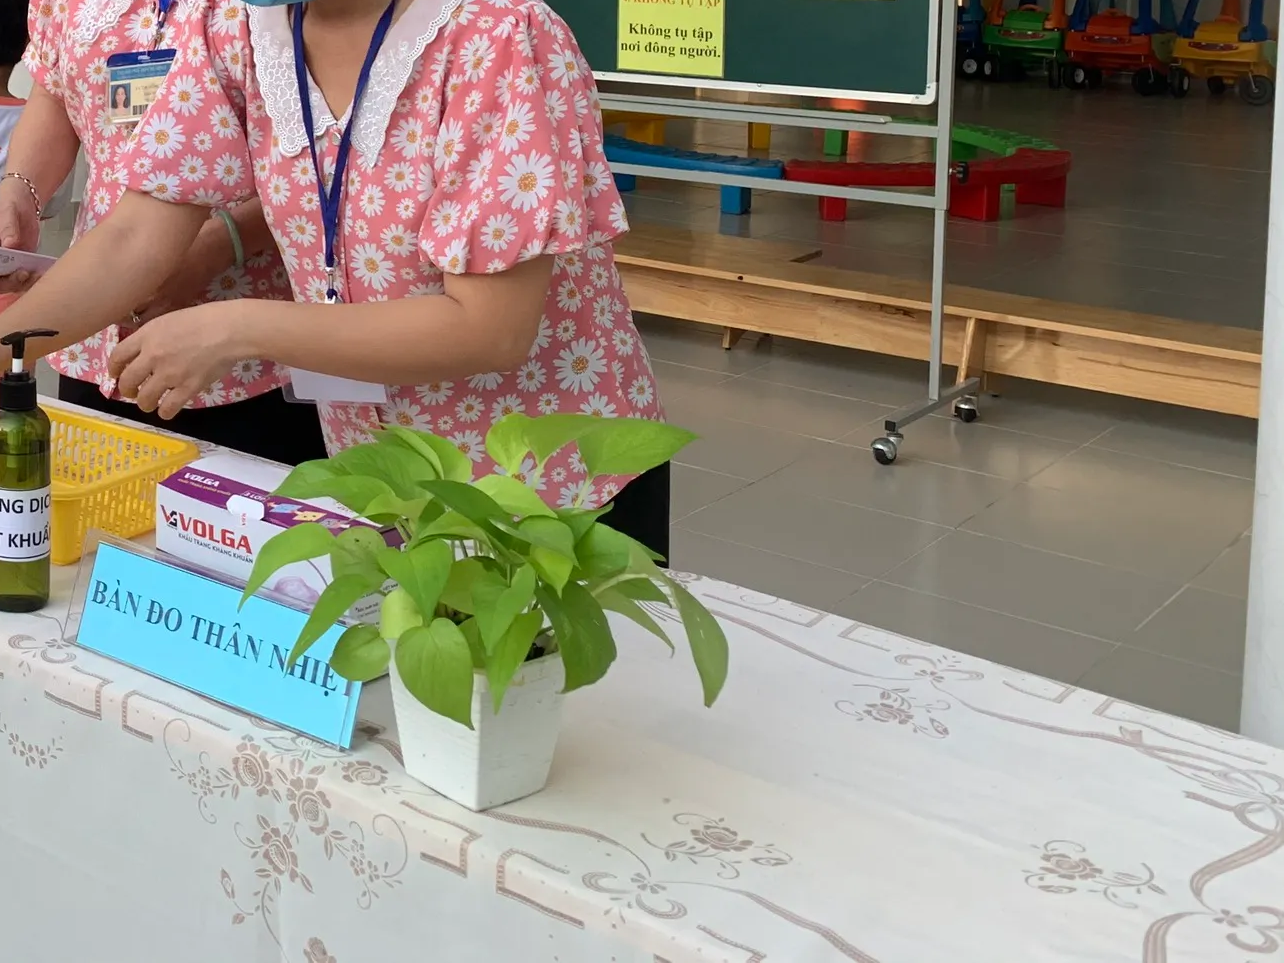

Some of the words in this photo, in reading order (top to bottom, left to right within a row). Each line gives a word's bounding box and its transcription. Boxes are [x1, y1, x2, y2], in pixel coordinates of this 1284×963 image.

[628, 23, 671, 40] Không
[675, 27, 687, 41] tụ
[692, 27, 713, 42] tập
[620, 41, 640, 52] nơi
[644, 41, 676, 57] đông
[679, 45, 721, 59] người.
[184, 472, 220, 488] VOLGA
[29, 493, 50, 514] DỊC
[8, 522, 50, 548] KHUẨ
[178, 512, 253, 555] VOLGA
[193, 538, 212, 550] TRANG
[91, 579, 142, 617] BÀN
[146, 599, 183, 633] ĐO
[190, 614, 264, 664] THÂN
